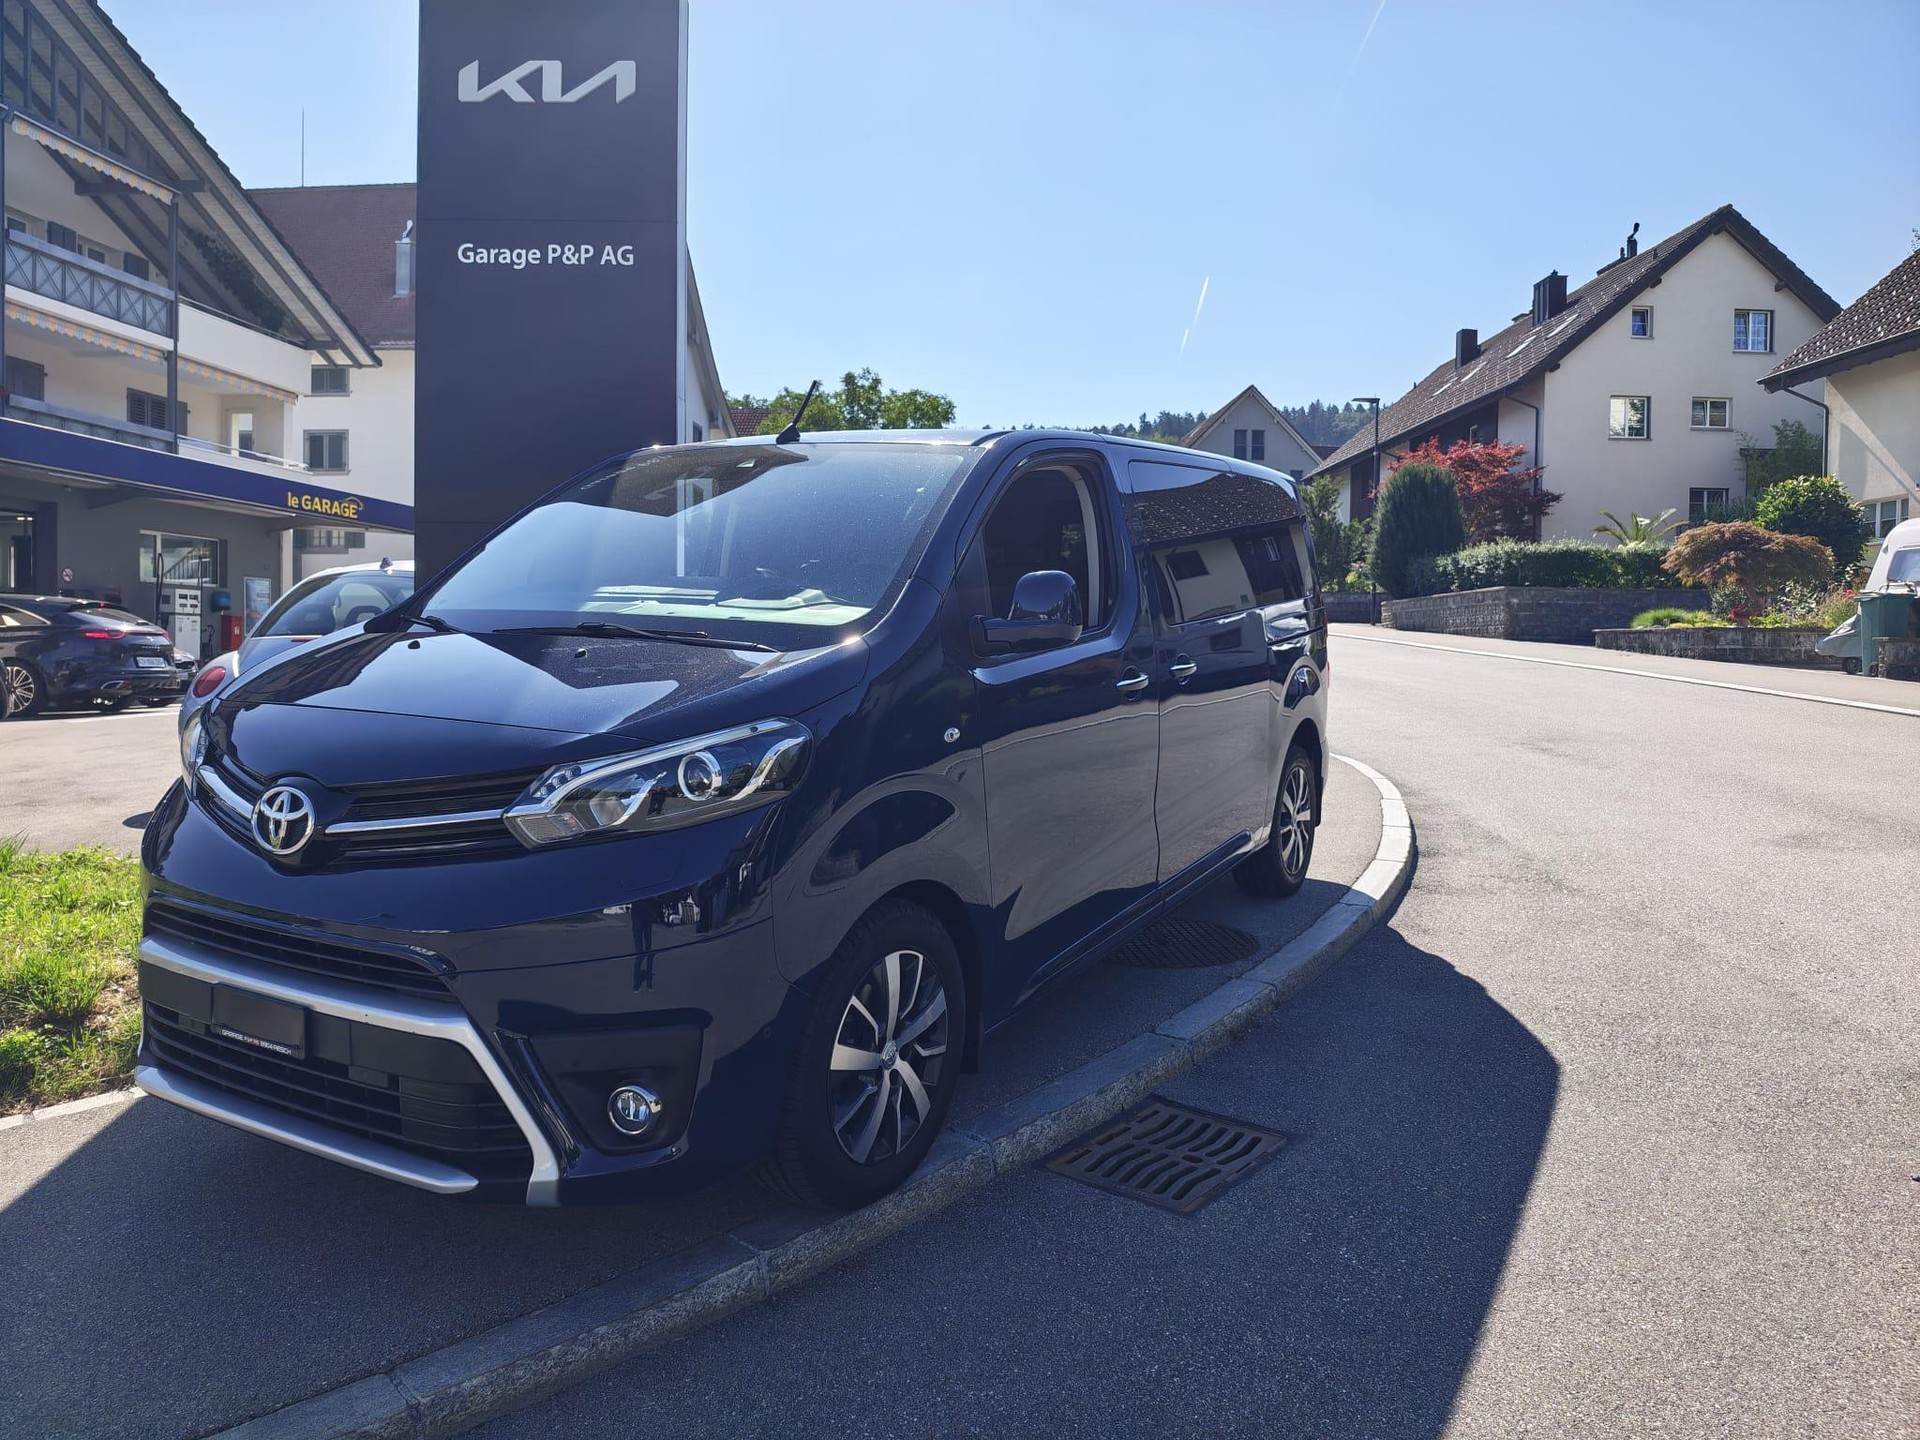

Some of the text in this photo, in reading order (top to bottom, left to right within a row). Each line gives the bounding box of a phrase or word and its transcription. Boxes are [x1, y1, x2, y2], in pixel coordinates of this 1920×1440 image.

[458, 60, 636, 104] KIA
[457, 243, 634, 269] Garage P&P AG
[287, 491, 358, 519] le GARAGE
